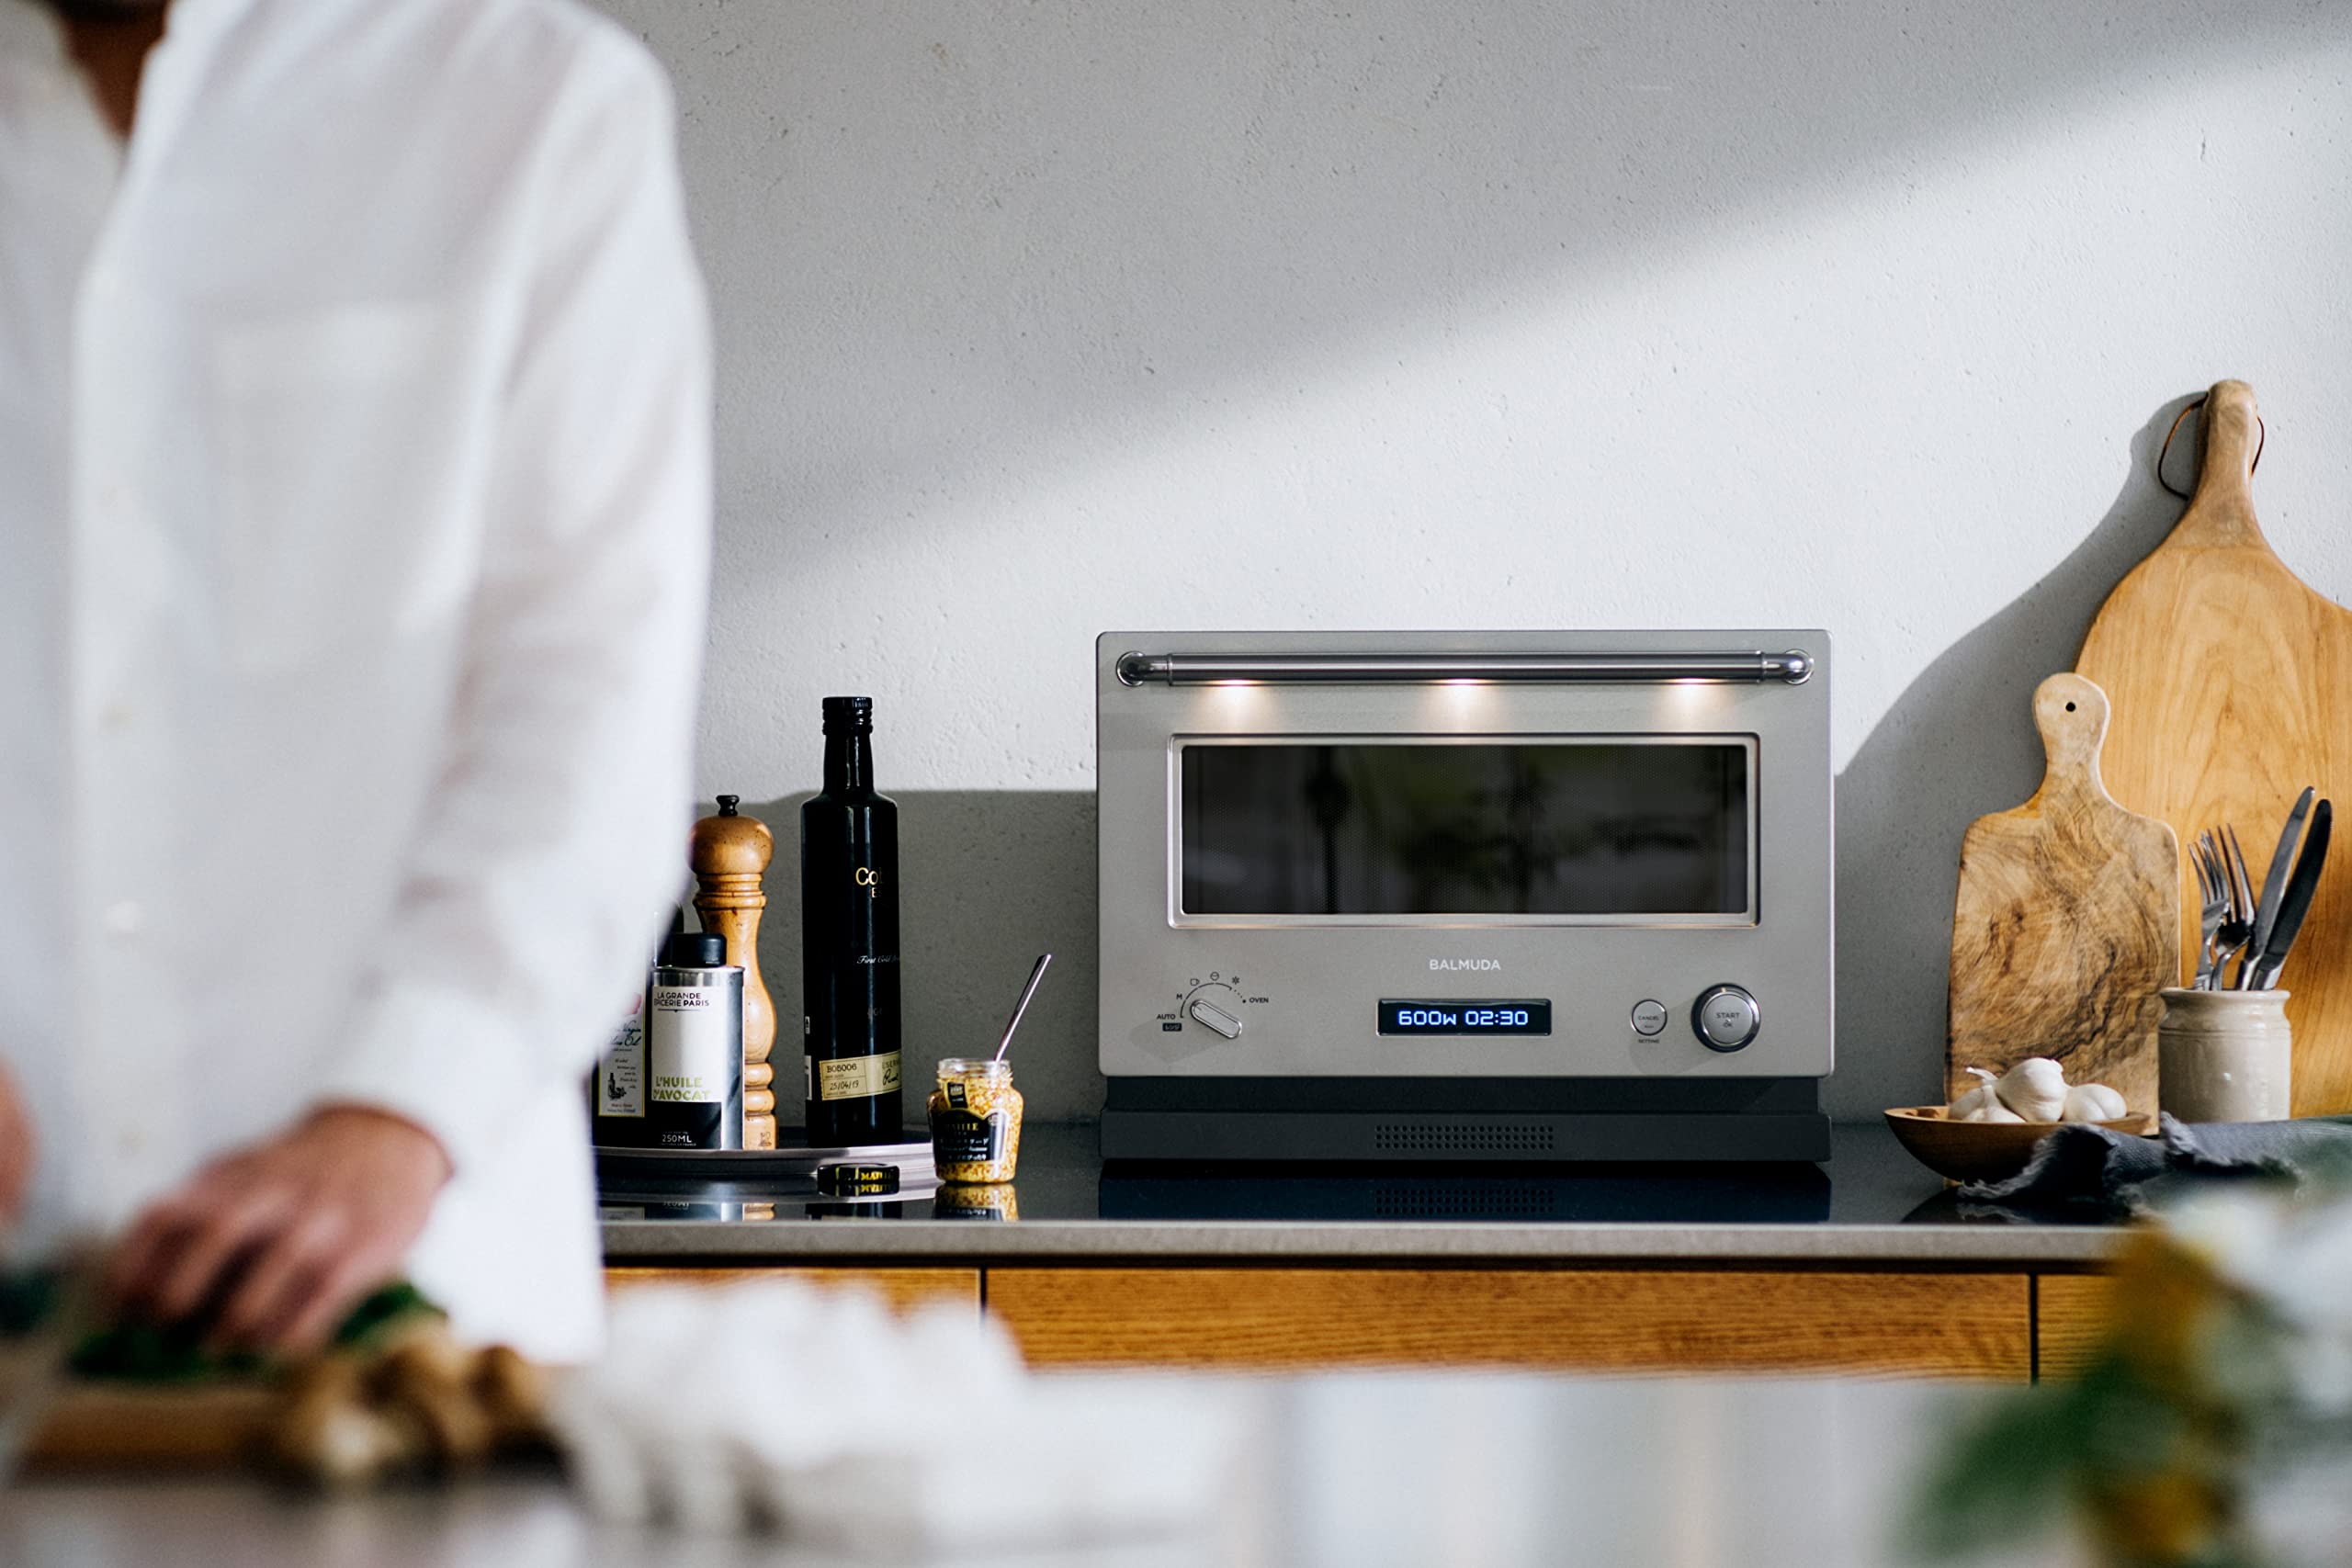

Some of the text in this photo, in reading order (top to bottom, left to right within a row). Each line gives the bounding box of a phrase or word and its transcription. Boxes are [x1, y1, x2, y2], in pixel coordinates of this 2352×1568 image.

[1429, 959, 1501, 971] BALMUDA
[1464, 1010, 1529, 1026] 02:30
[655, 1076, 702, 1088] L'HUILE
[662, 1134, 693, 1143] 250ML
